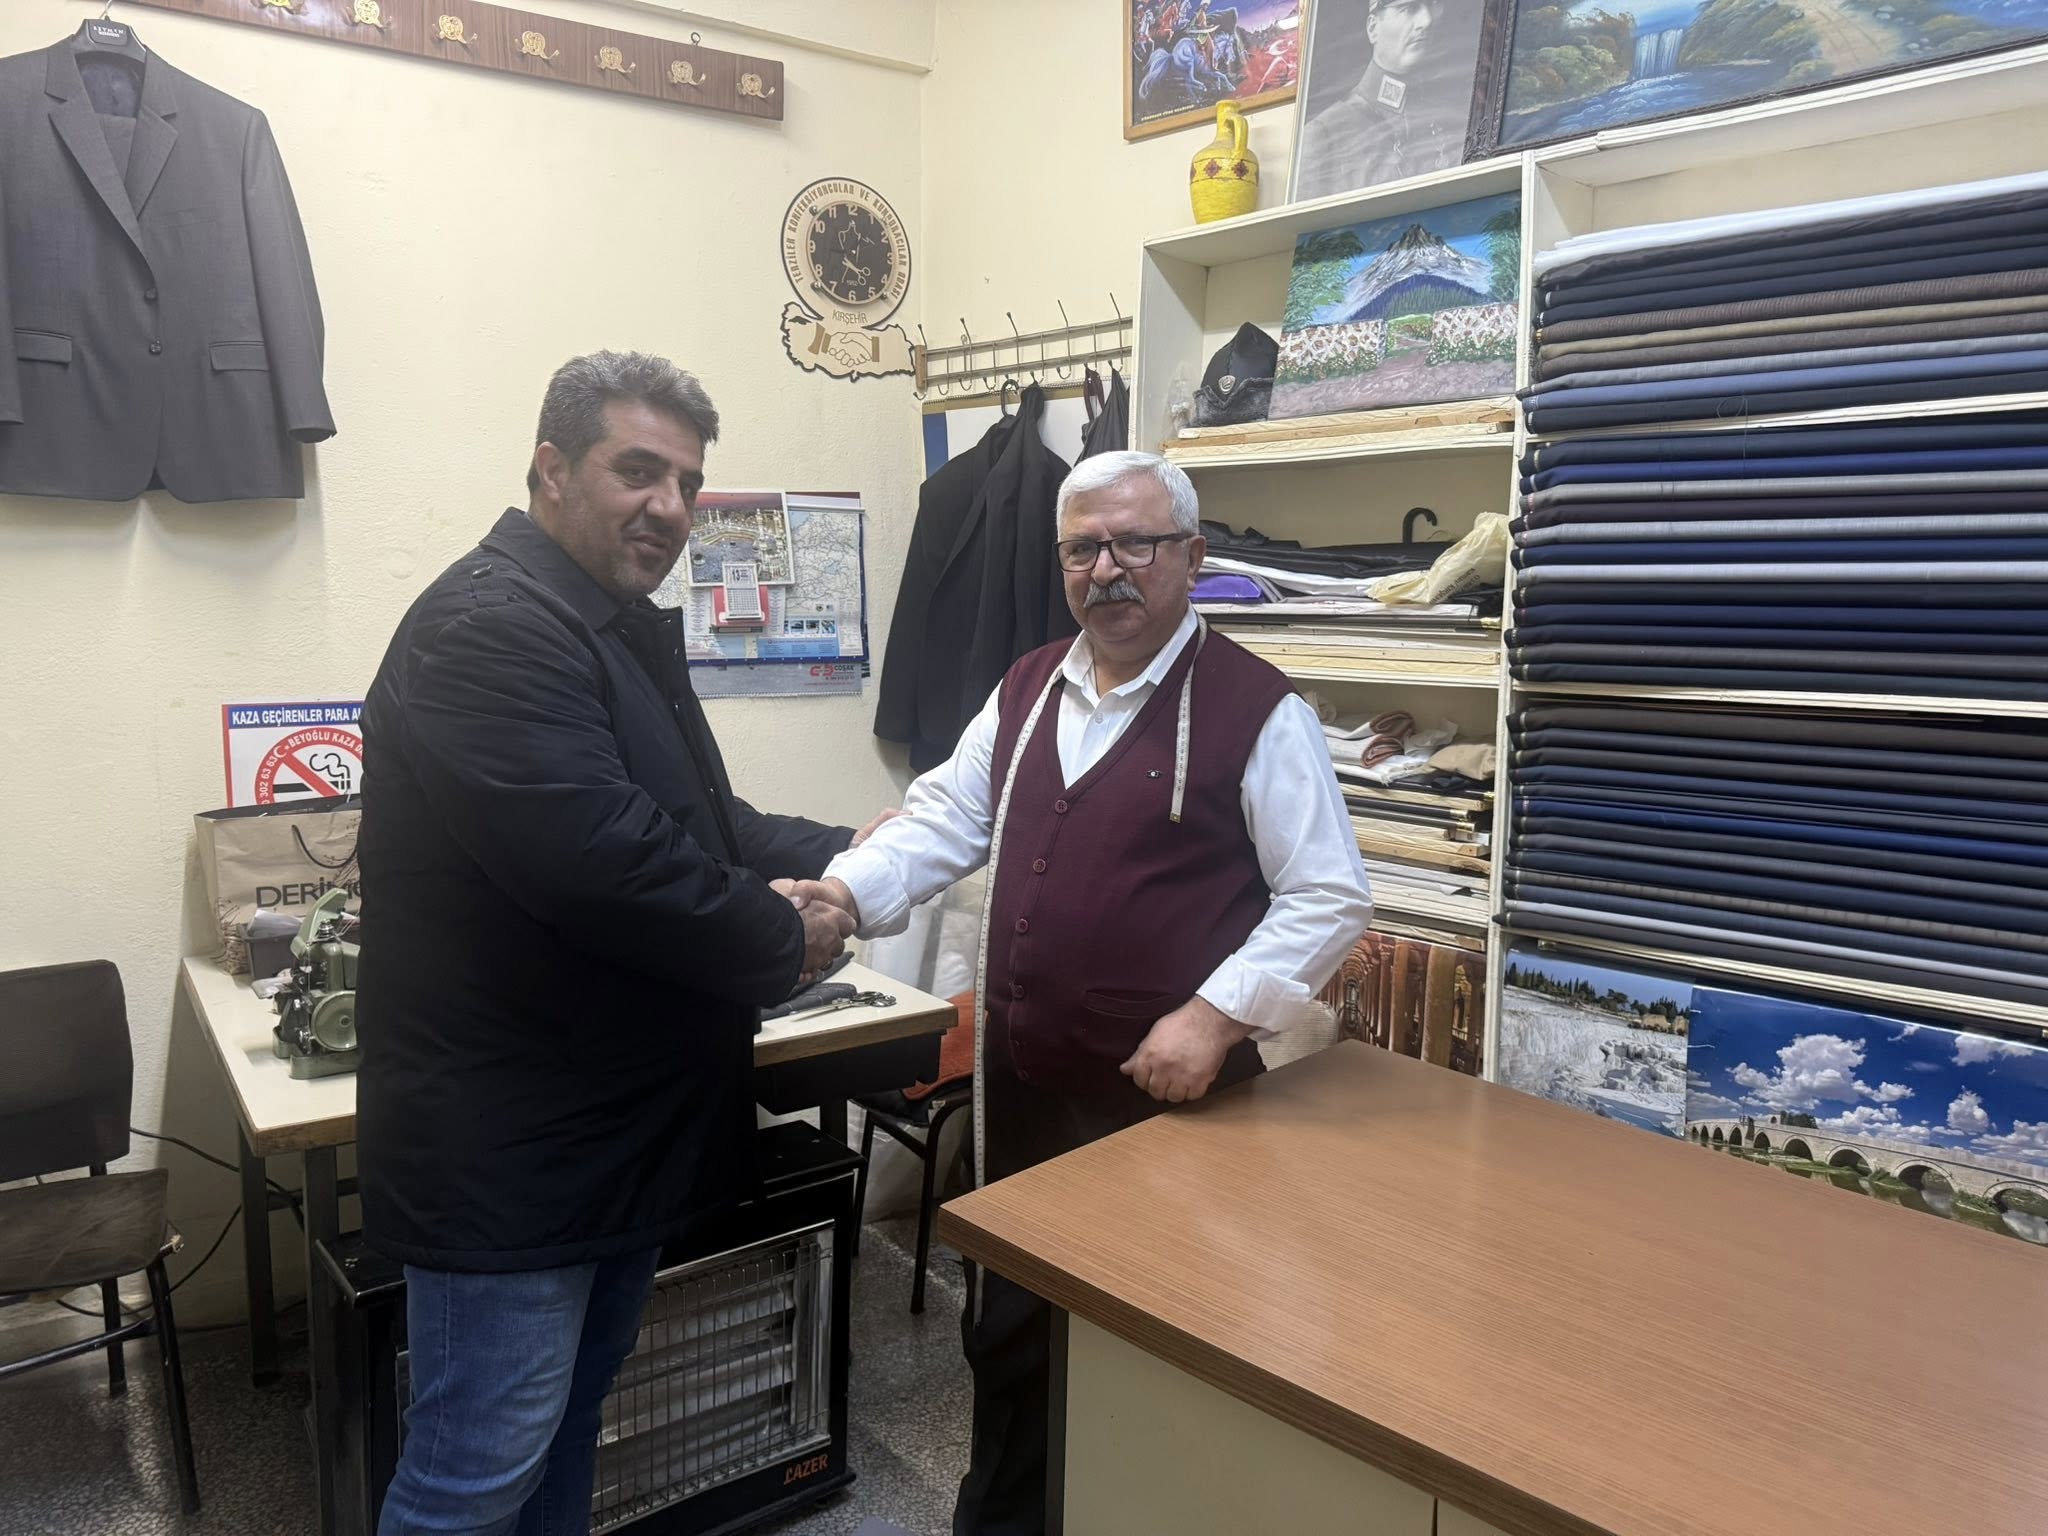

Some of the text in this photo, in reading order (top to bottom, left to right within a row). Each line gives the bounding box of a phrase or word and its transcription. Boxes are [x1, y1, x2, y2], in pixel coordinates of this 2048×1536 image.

[829, 206, 837, 219] 11
[848, 204, 858, 216] 12
[868, 213, 875, 225] 1
[815, 220, 826, 234] 10
[860, 187, 870, 201] VE
[891, 271, 906, 300] ODASI
[881, 230, 889, 244] 2
[809, 240, 816, 253] 9
[887, 252, 893, 265] 3
[815, 263, 823, 277] 8
[881, 273, 888, 285] 4
[829, 280, 838, 294] 7
[868, 286, 876, 299] 5
[848, 290, 856, 302] 6
[832, 309, 868, 325] KIRŞEHİR
[232, 711, 260, 725] KAZA
[262, 706, 323, 727] GEÇİRENLER
[325, 708, 350, 722] PARA
[288, 729, 330, 747] BEYOĞLU
[332, 732, 356, 749] KAZA
[266, 755, 278, 768] 63
[261, 767, 272, 779] 63
[259, 781, 269, 797] 302
[783, 1454, 828, 1486] LAZER
